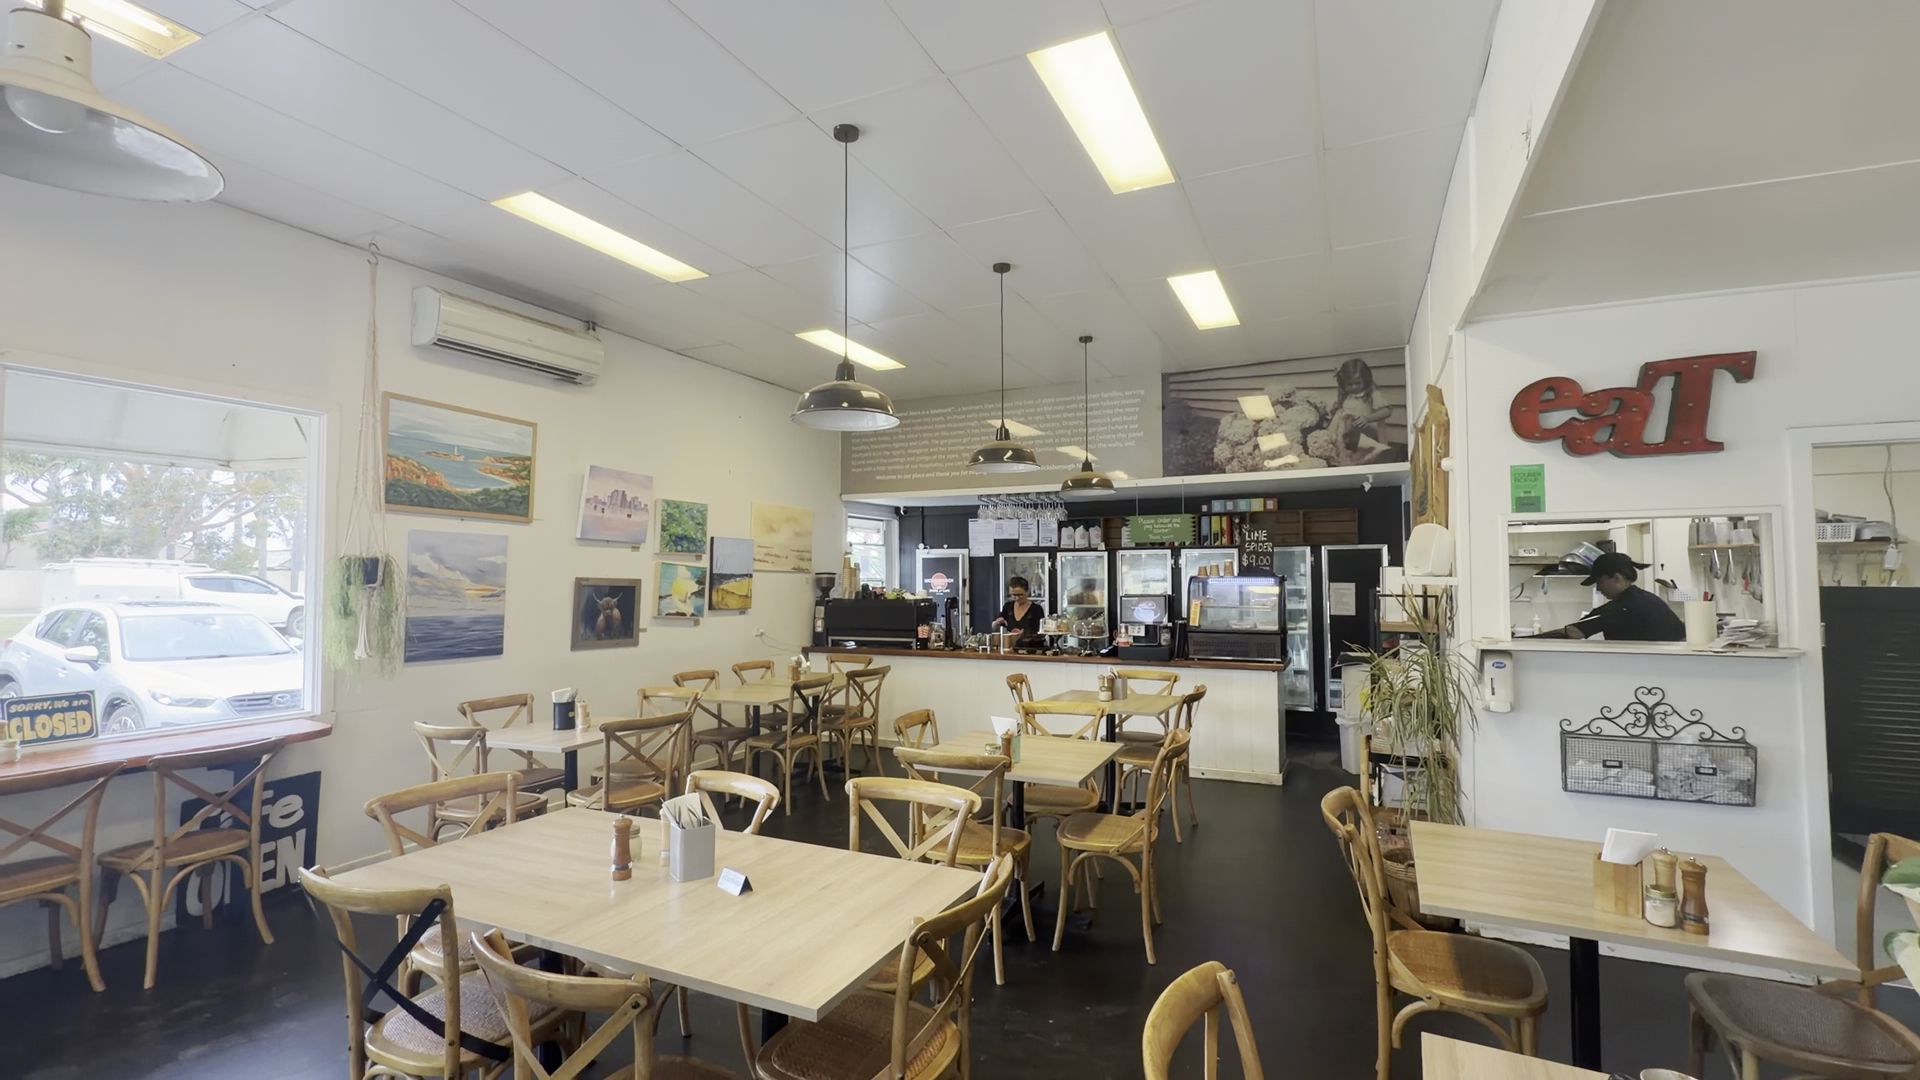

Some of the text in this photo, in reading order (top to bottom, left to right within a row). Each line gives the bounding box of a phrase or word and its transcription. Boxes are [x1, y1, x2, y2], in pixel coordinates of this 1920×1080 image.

[1245, 530, 1268, 542] LIME
[1245, 542, 1273, 553] SPIDER
[1241, 553, 1271, 567] $9.00
[9, 699, 89, 713] SORRY, We are
[9, 710, 93, 741] CLOSED
[183, 828, 307, 917] OEN
